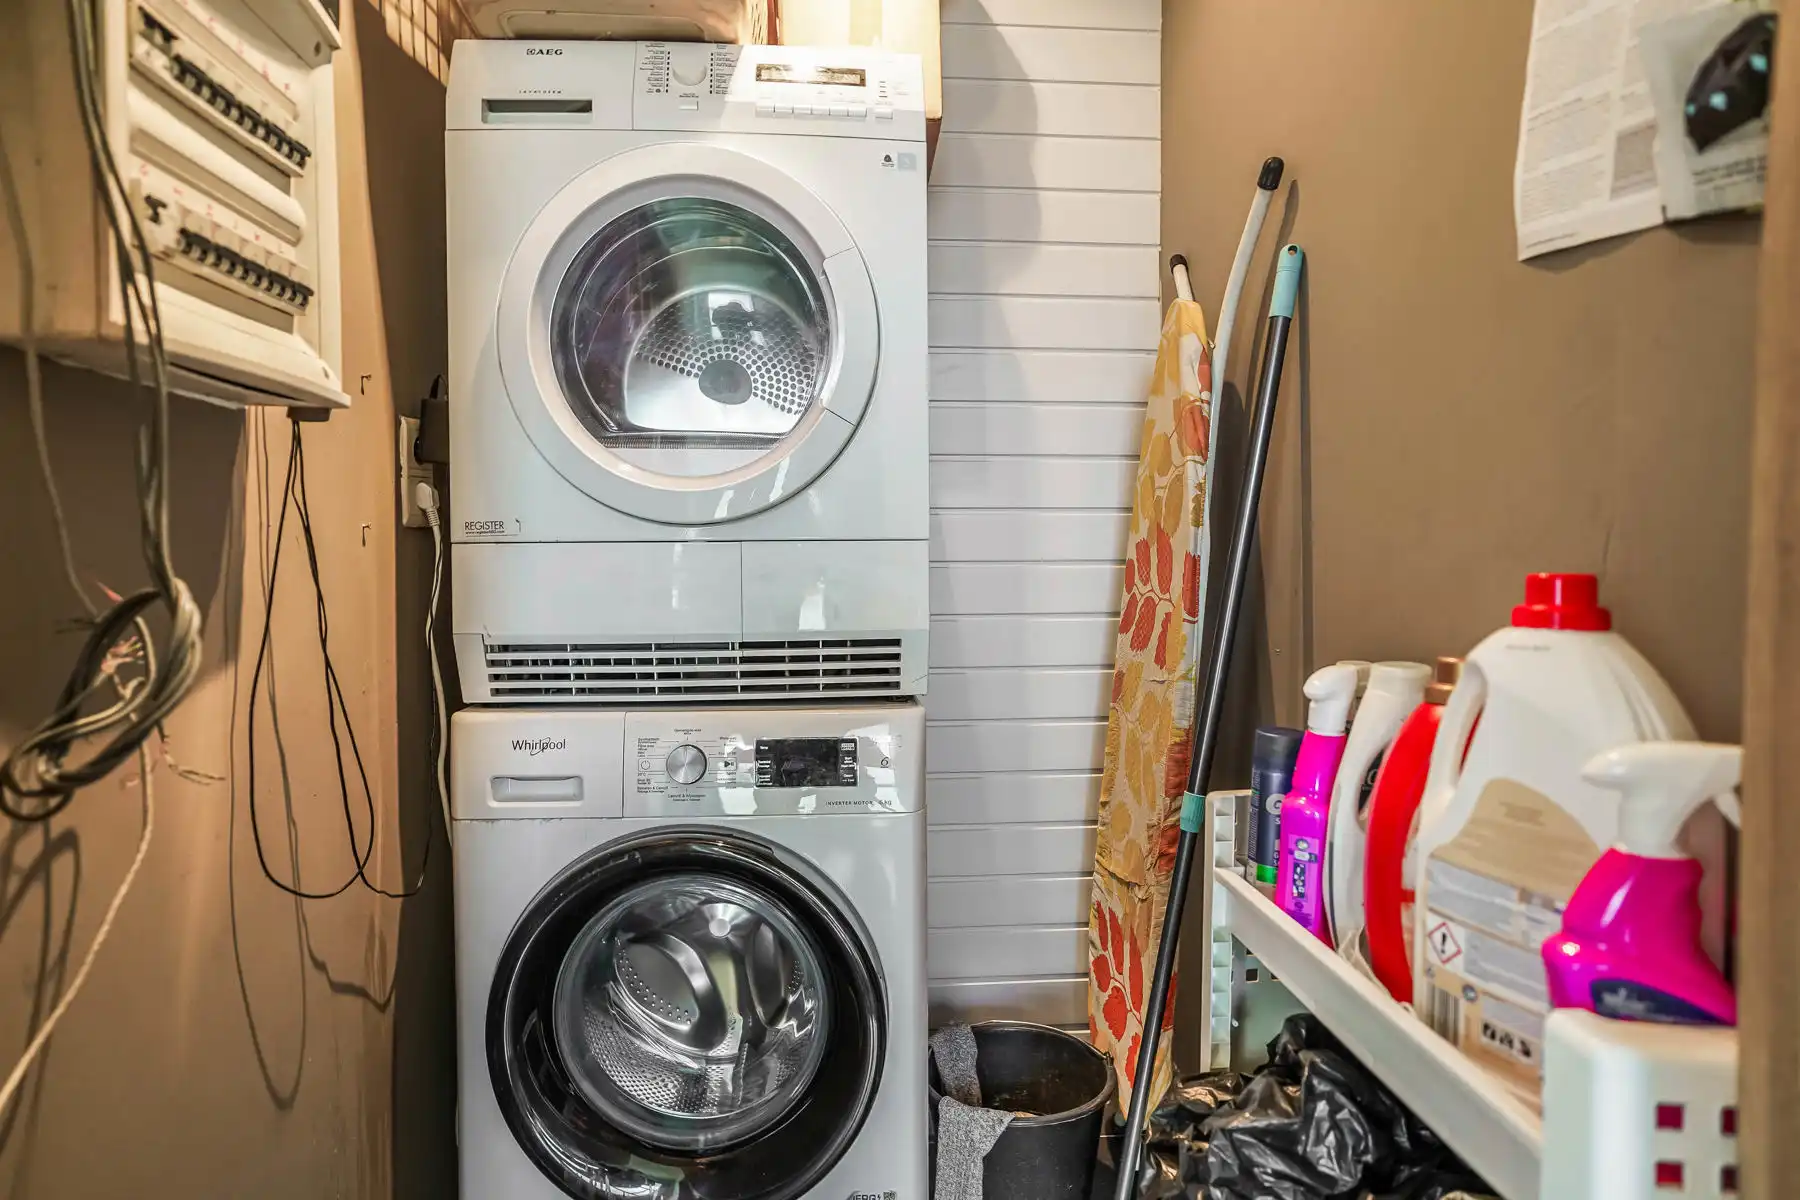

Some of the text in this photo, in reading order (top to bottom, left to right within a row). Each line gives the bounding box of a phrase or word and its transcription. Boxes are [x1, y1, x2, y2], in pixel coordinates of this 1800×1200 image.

[535, 48, 563, 56] AEG
[464, 520, 505, 531] REGISTER
[512, 737, 566, 755] Whirlpool
